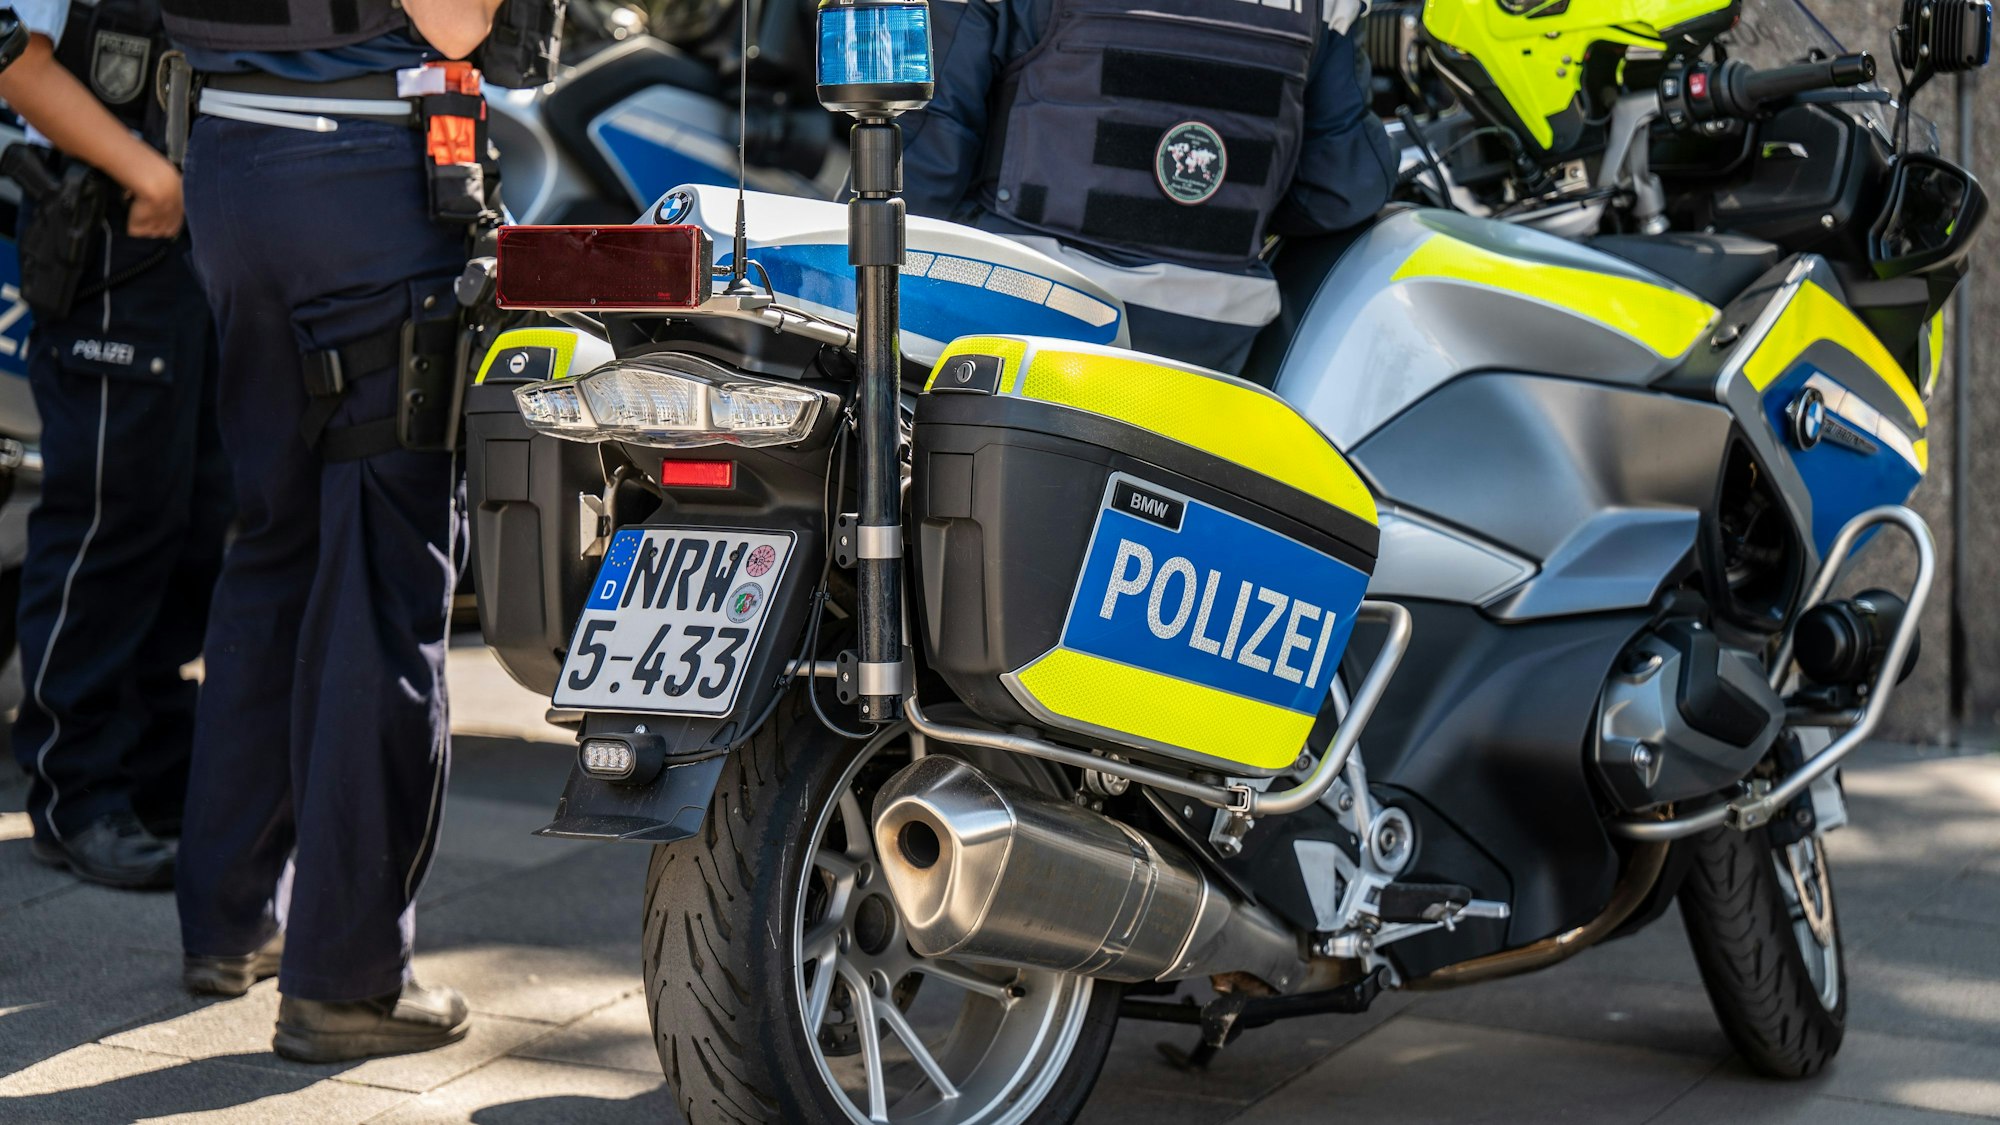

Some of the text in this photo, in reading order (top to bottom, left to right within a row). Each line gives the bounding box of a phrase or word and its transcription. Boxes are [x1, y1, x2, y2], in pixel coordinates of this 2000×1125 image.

[72, 339, 135, 365] POLIZEI
[1130, 492, 1169, 519] BMW
[600, 580, 617, 600] D
[621, 537, 749, 613] NRW
[1099, 538, 1337, 689] POLIZEI
[568, 619, 750, 699] 5-433
